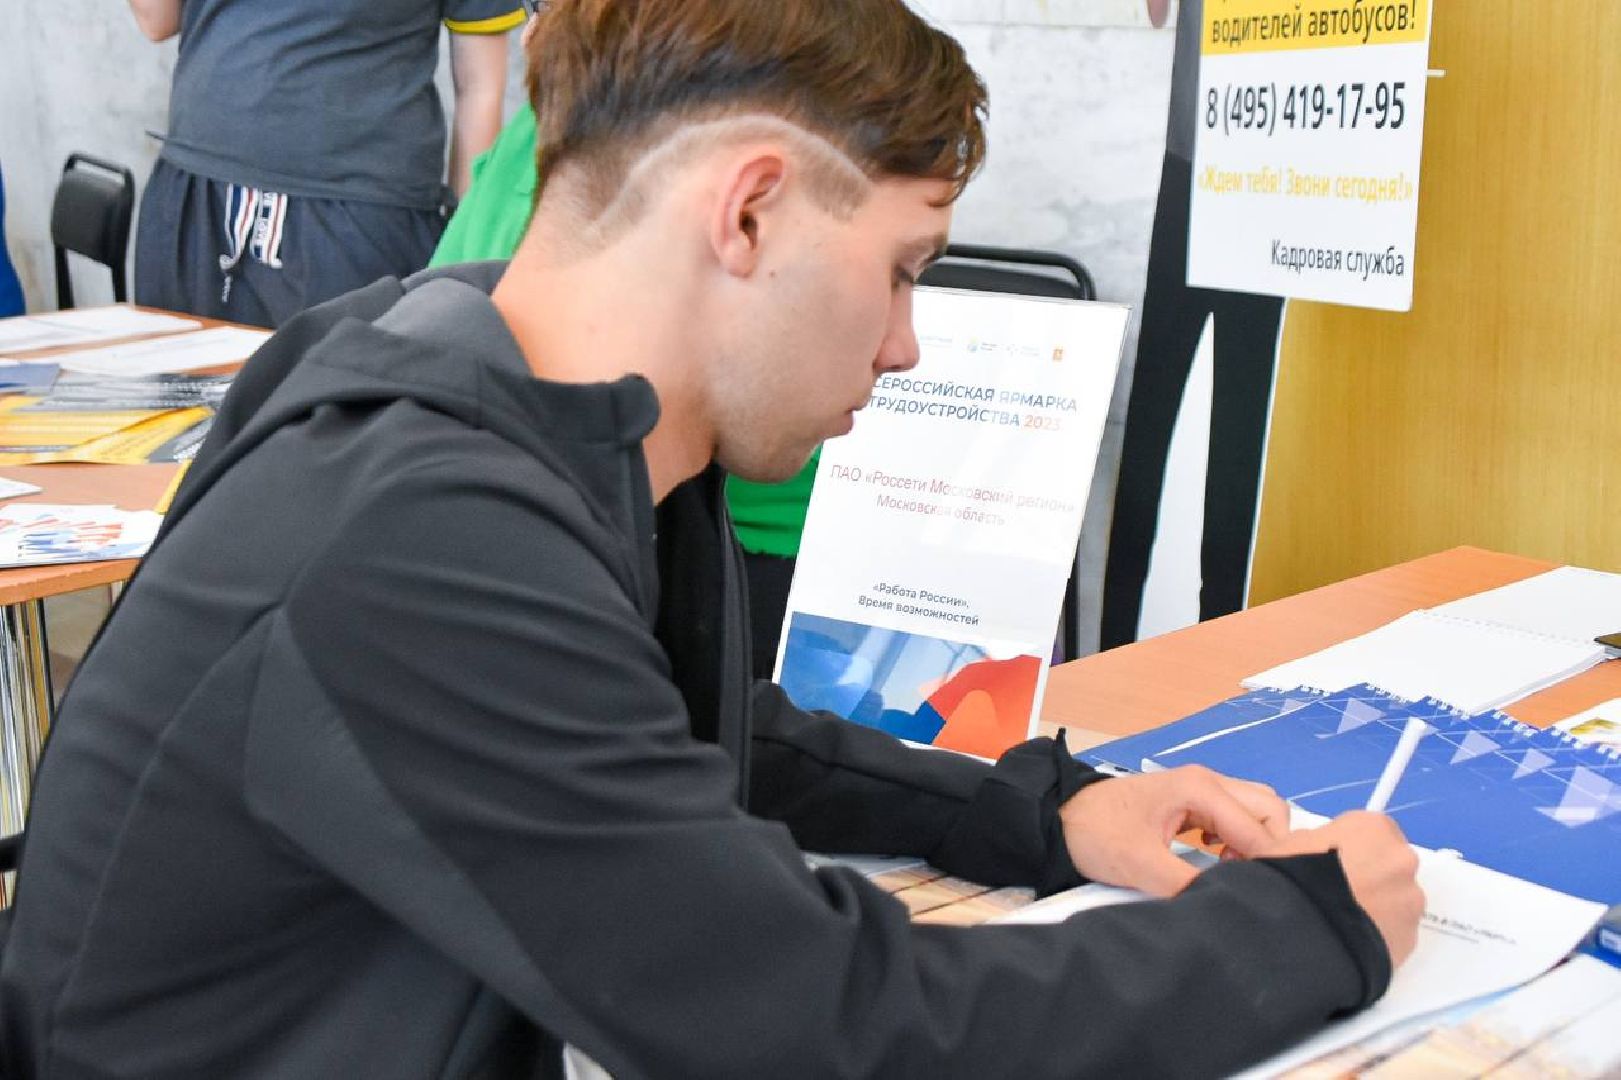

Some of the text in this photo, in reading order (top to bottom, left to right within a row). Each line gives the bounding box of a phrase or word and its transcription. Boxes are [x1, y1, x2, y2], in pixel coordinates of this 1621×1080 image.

[1212, 0, 1416, 47] водителей автобусов!
[1206, 82, 1406, 136] 8 (495) 419-17-95
[1285, 168, 1331, 196] Звони
[1271, 239, 1405, 281] Кадровая служба
[870, 395, 1020, 427] ТРУДОУСТРОЙСТВА
[999, 390, 1078, 412] ЯРМАРКА
[830, 464, 861, 482] ПАО
[865, 471, 927, 492] «Россети
[858, 595, 979, 626] Время возможностей
